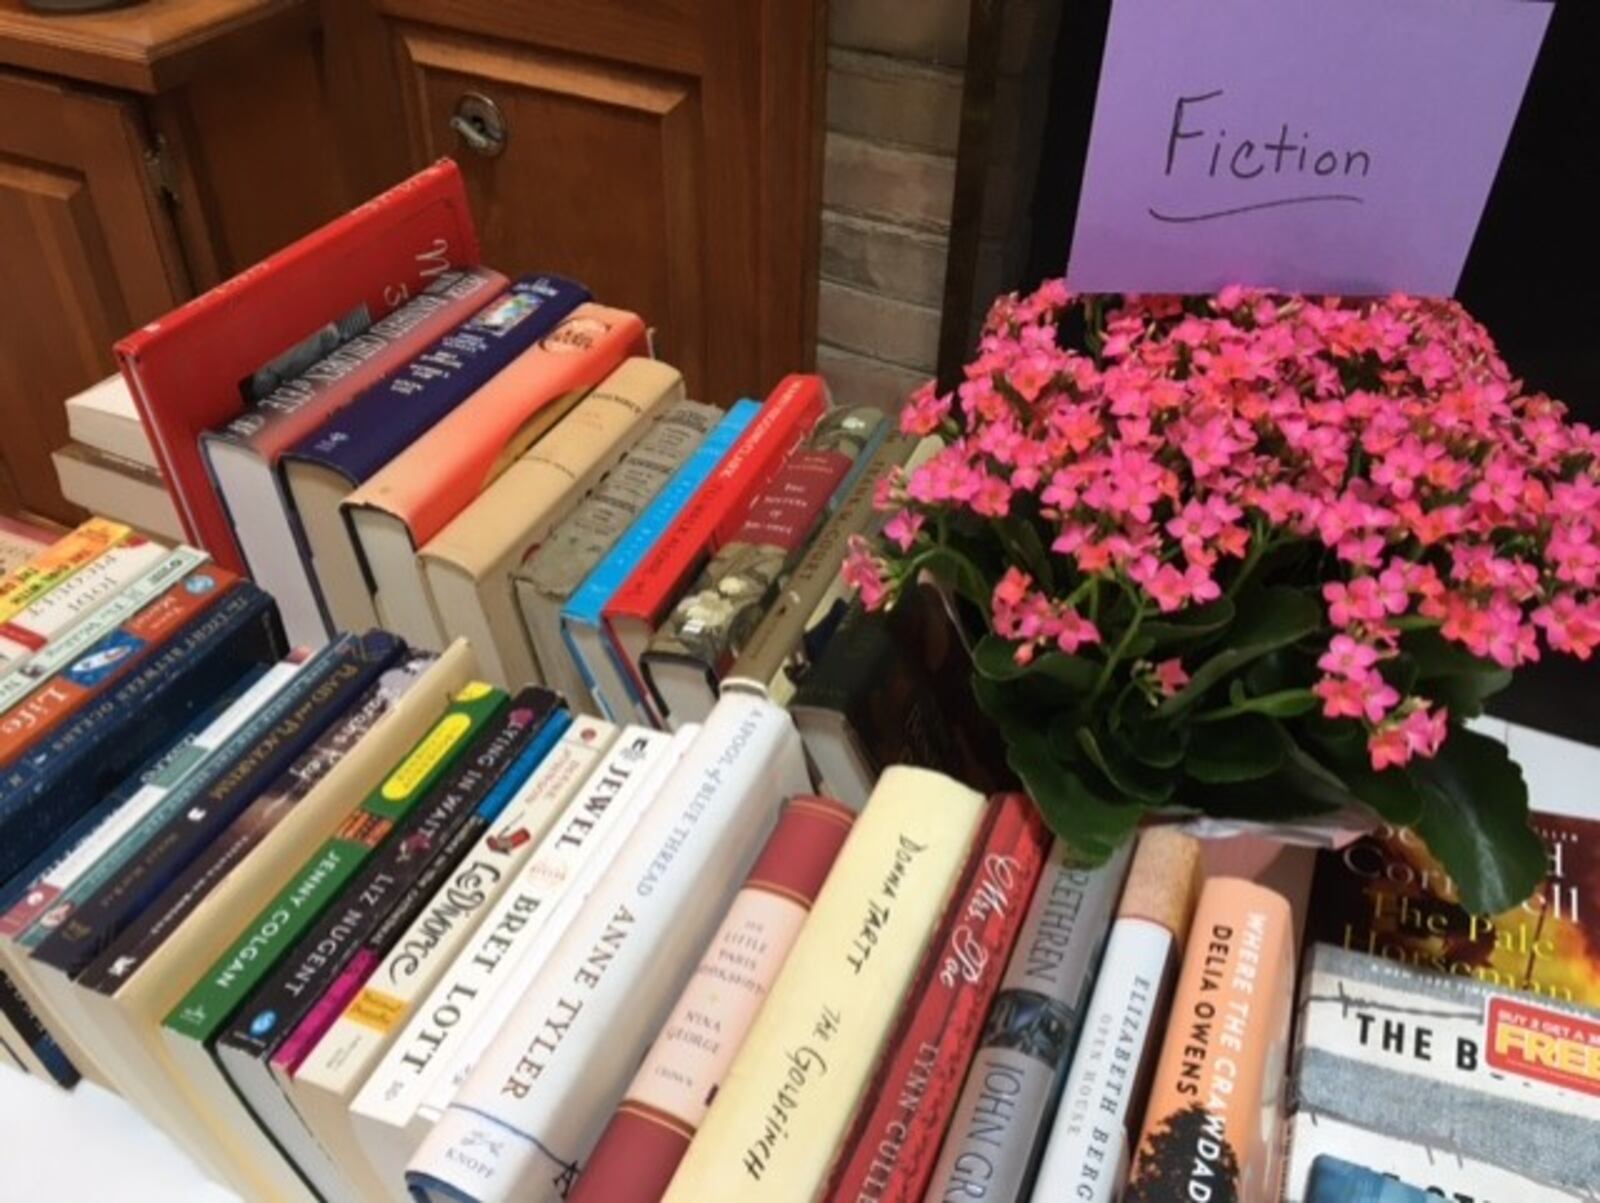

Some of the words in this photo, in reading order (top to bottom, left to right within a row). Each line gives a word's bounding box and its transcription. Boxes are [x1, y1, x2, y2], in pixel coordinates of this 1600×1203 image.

[1165, 90, 1370, 178] Fiction
[2, 687, 67, 736] Life
[424, 792, 463, 836] WAIT
[459, 769, 482, 790] IN
[556, 763, 630, 849] JEWEL
[292, 849, 340, 907] JENNY
[359, 872, 394, 907] LIZ
[636, 820, 690, 898] THREAD
[886, 833, 929, 900] DONNA
[216, 909, 290, 989] COLGAN
[285, 909, 362, 997] NUGENT
[473, 894, 541, 973] BRET
[574, 905, 636, 990] ANNE
[847, 900, 891, 976] TARTT
[1201, 924, 1233, 992] DELIA
[1234, 912, 1268, 994] WHERE
[1470, 913, 1554, 960] Pale
[401, 983, 478, 1075] LOTT
[500, 997, 584, 1100] TYLER
[665, 1026, 721, 1054] GEORGE
[686, 1009, 722, 1032] NINA
[1100, 975, 1151, 1115] ELIZABETH
[1176, 1002, 1216, 1096] OWENS
[1219, 1000, 1249, 1051] THE
[1355, 1013, 1433, 1062] THE
[1497, 1010, 1528, 1025] BUY
[1541, 1021, 1571, 1036] GET
[897, 1042, 941, 1113] LYNN
[967, 1061, 1025, 1146] JOHN
[446, 1147, 496, 1180] KNOPF
[1077, 1126, 1108, 1200] BERG
